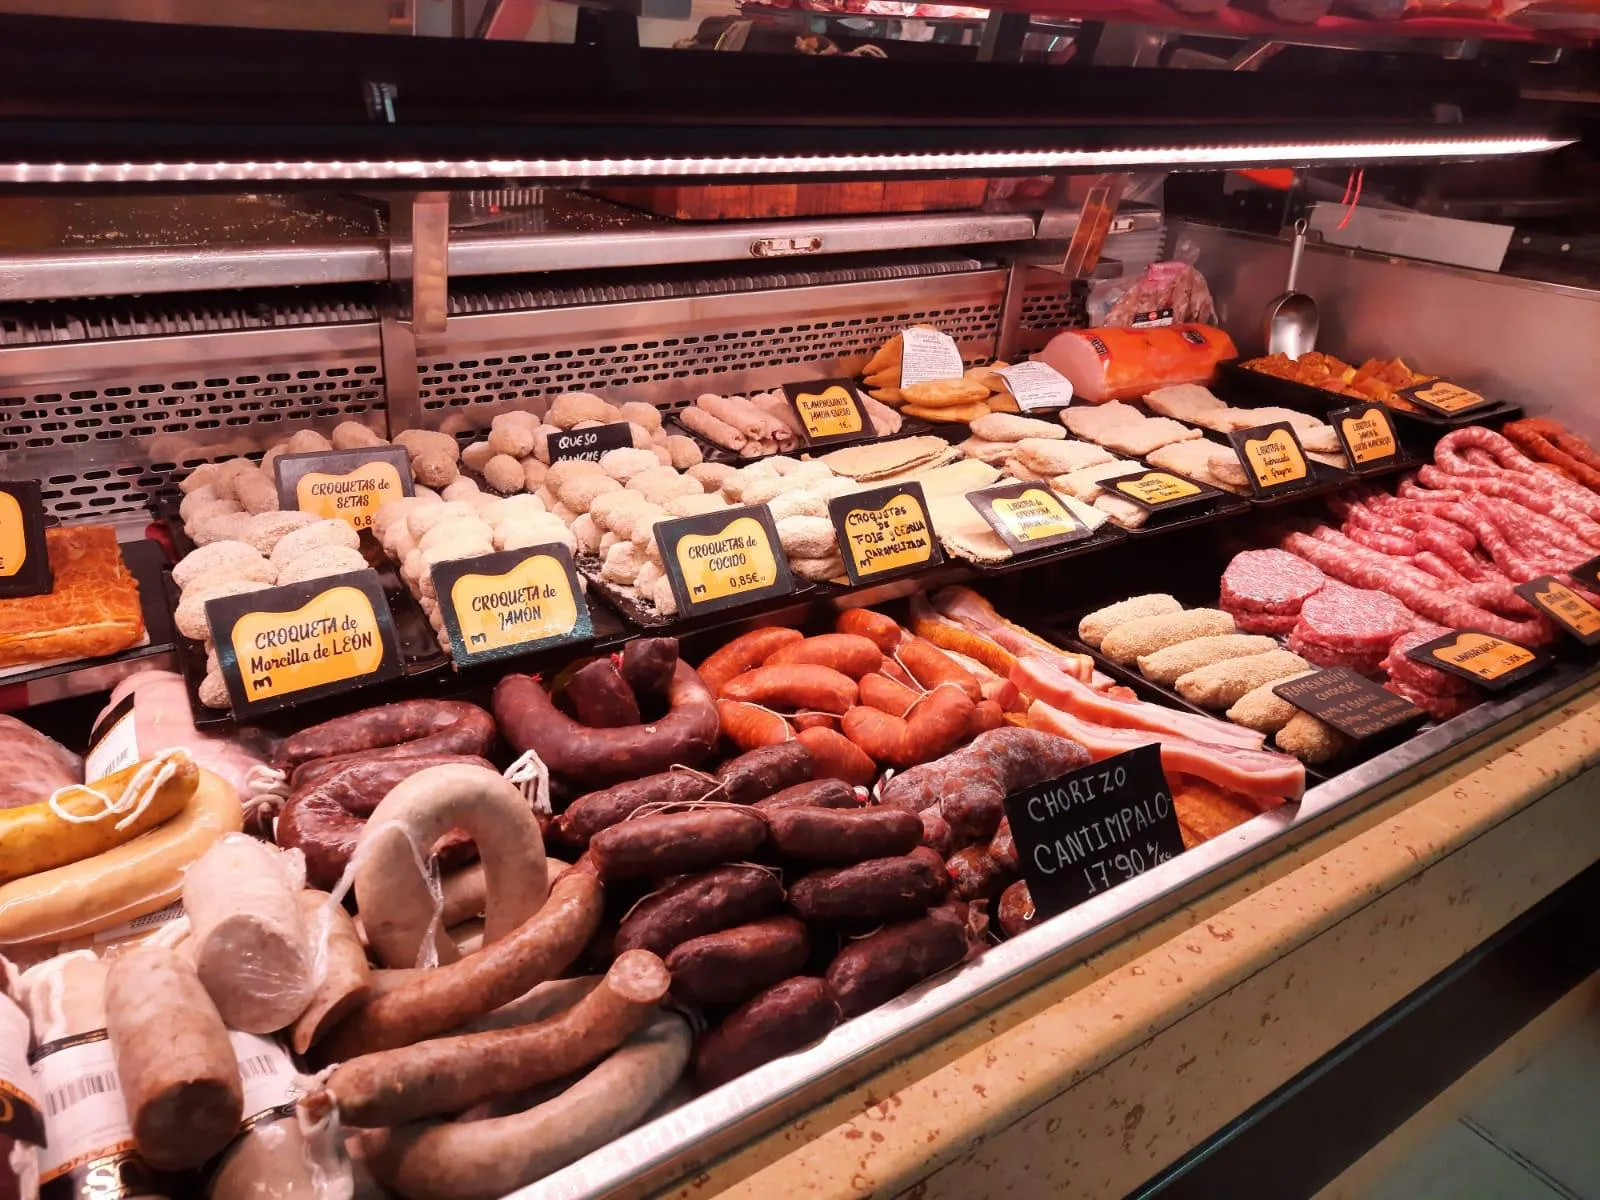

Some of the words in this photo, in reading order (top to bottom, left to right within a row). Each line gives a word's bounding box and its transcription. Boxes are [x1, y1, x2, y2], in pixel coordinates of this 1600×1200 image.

[558, 433, 598, 449] QUESO
[311, 479, 376, 496] CROQUETAS
[378, 479, 390, 490] de
[336, 494, 369, 509] SETAS
[688, 536, 745, 560] CROQUETAS
[745, 535, 758, 548] de
[852, 532, 884, 545] FOIE
[708, 553, 746, 572] COCIDO
[729, 572, 760, 589] 0,85€
[471, 585, 540, 613] CROQUETA
[542, 584, 557, 600] de
[498, 602, 542, 632] JAMÓN
[255, 617, 337, 650] CROQUETA
[340, 615, 358, 631] de
[251, 647, 310, 675] Morcilla
[313, 643, 329, 660] de
[332, 628, 373, 656] LEÓN
[1027, 766, 1126, 822] CHORIZO
[1033, 792, 1169, 874] CANTIMPALO
[1083, 848, 1145, 894] 17'90
